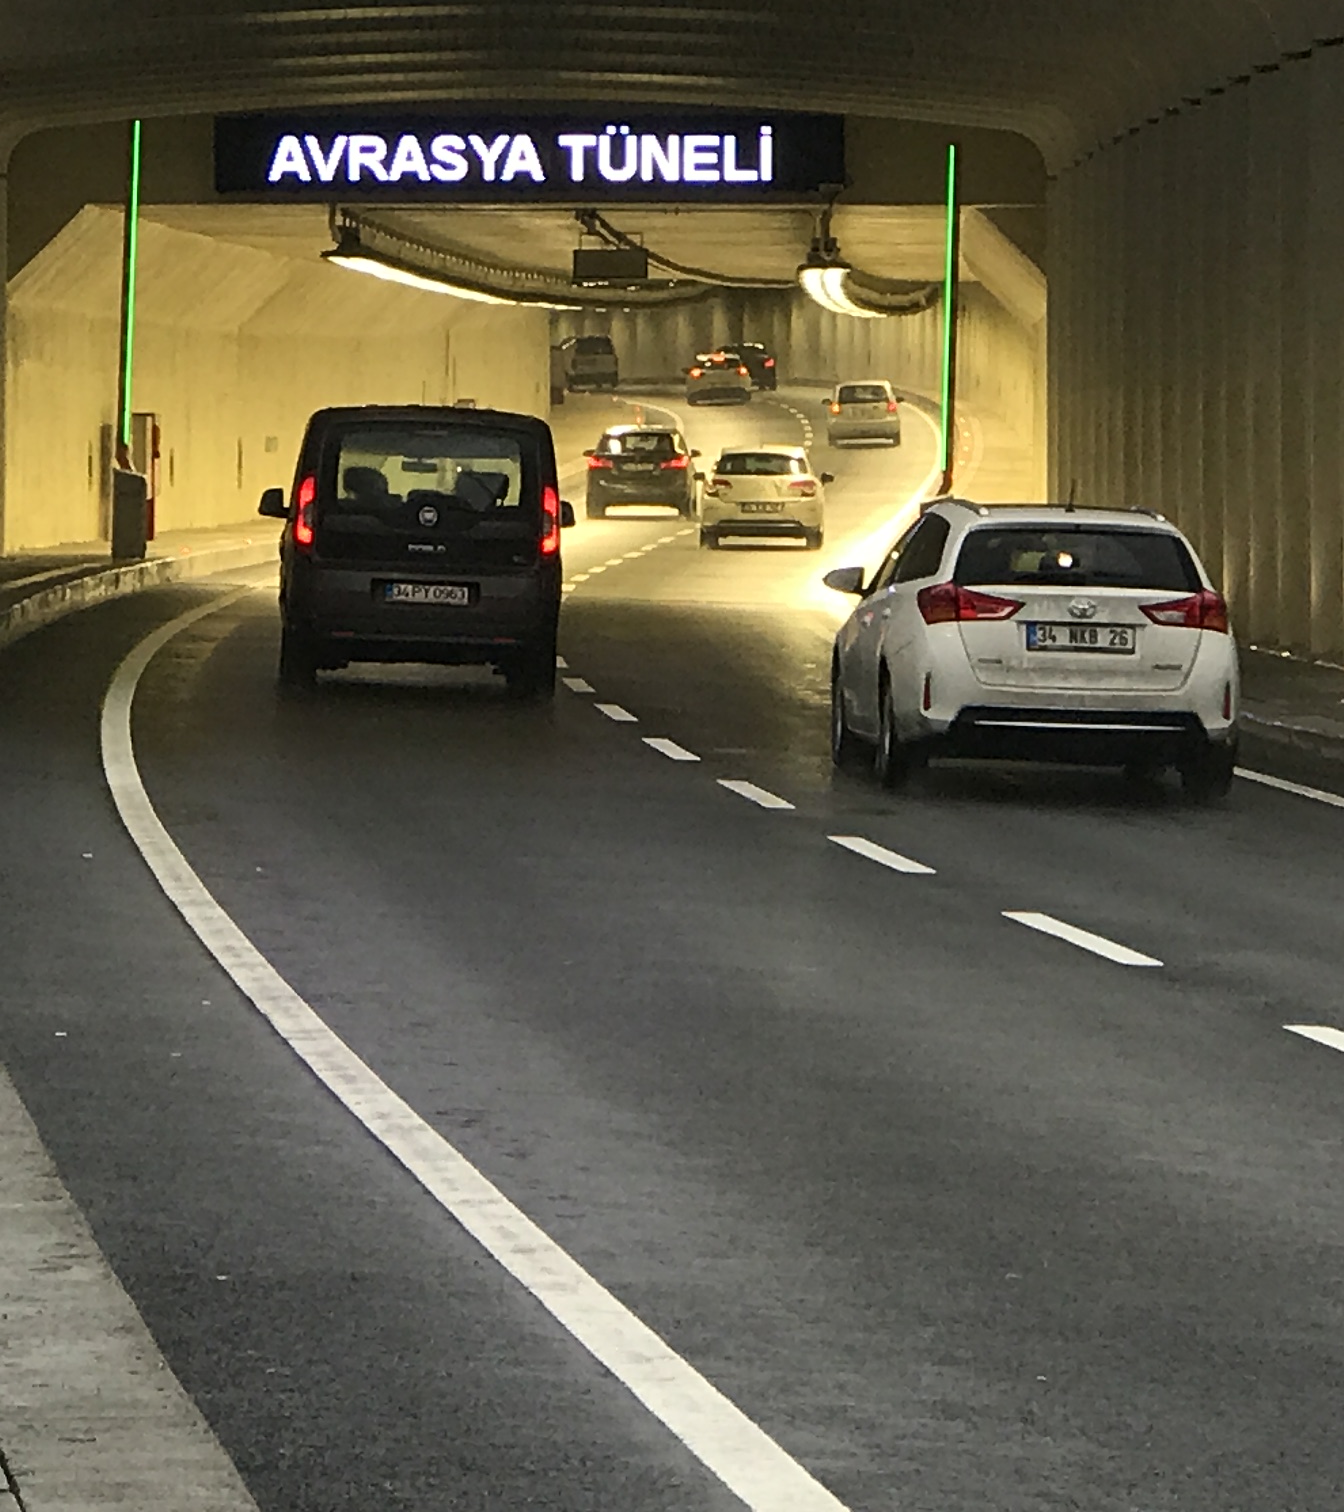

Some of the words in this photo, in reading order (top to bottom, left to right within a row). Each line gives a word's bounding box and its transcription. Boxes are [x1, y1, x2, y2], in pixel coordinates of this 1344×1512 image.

[268, 133, 545, 182] AVRASYA
[558, 125, 774, 182] TÜNELİ
[1038, 626, 1057, 644] 34
[1109, 629, 1129, 646] 26
